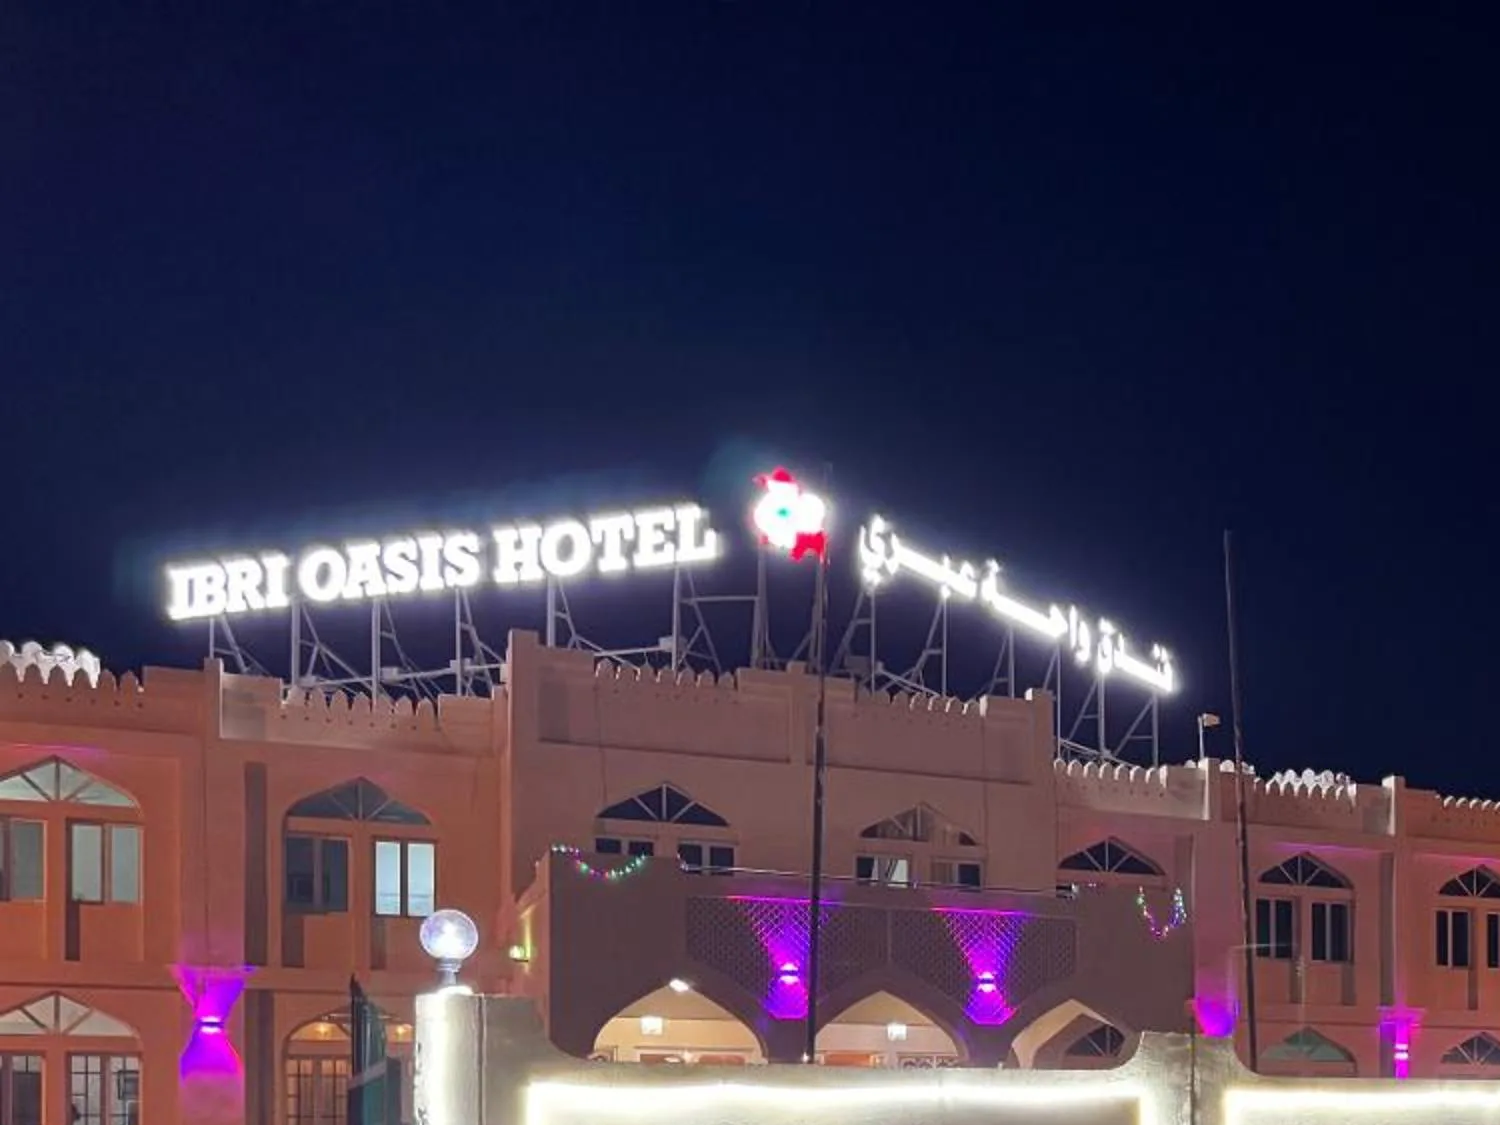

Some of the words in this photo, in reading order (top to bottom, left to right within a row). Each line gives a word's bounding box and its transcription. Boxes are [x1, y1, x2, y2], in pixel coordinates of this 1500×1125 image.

[166, 555, 292, 622] IBRI
[299, 531, 482, 602] OASIS
[492, 503, 719, 586] HOTEL
